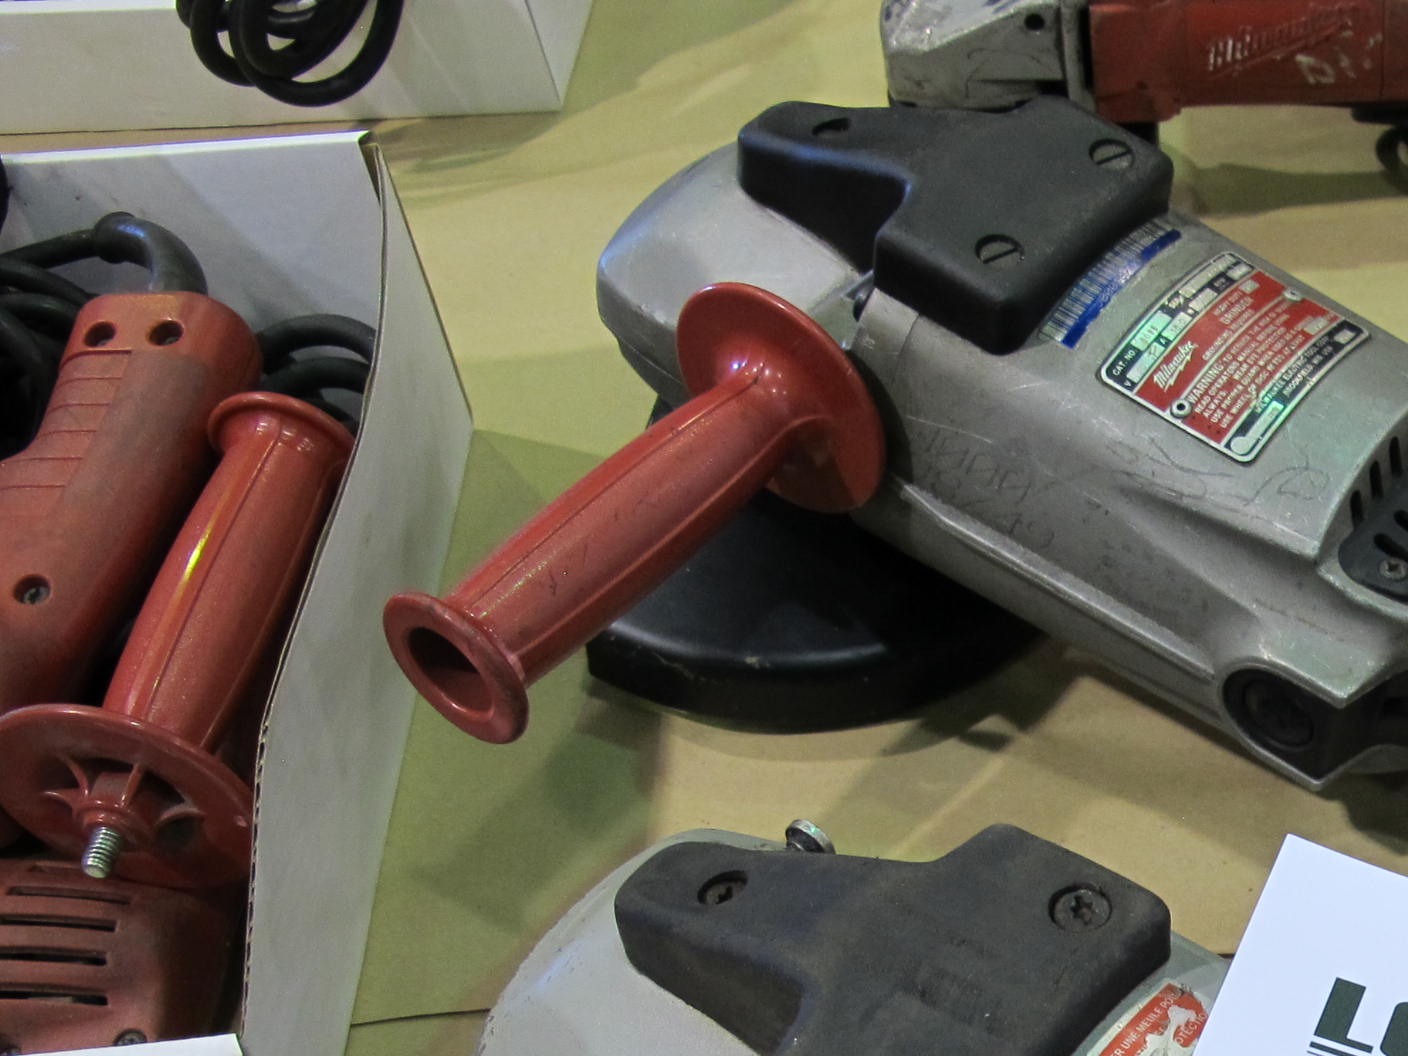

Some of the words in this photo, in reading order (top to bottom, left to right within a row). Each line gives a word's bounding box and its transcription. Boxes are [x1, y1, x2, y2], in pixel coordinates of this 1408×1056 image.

[1114, 360, 1127, 375] CAT.
[1152, 341, 1198, 391] Milwaukee
[1195, 396, 1212, 413] READ
[1213, 410, 1224, 422] USE
[1122, 1030, 1141, 1050] UNE
[1137, 1006, 1163, 1034] MEULE
